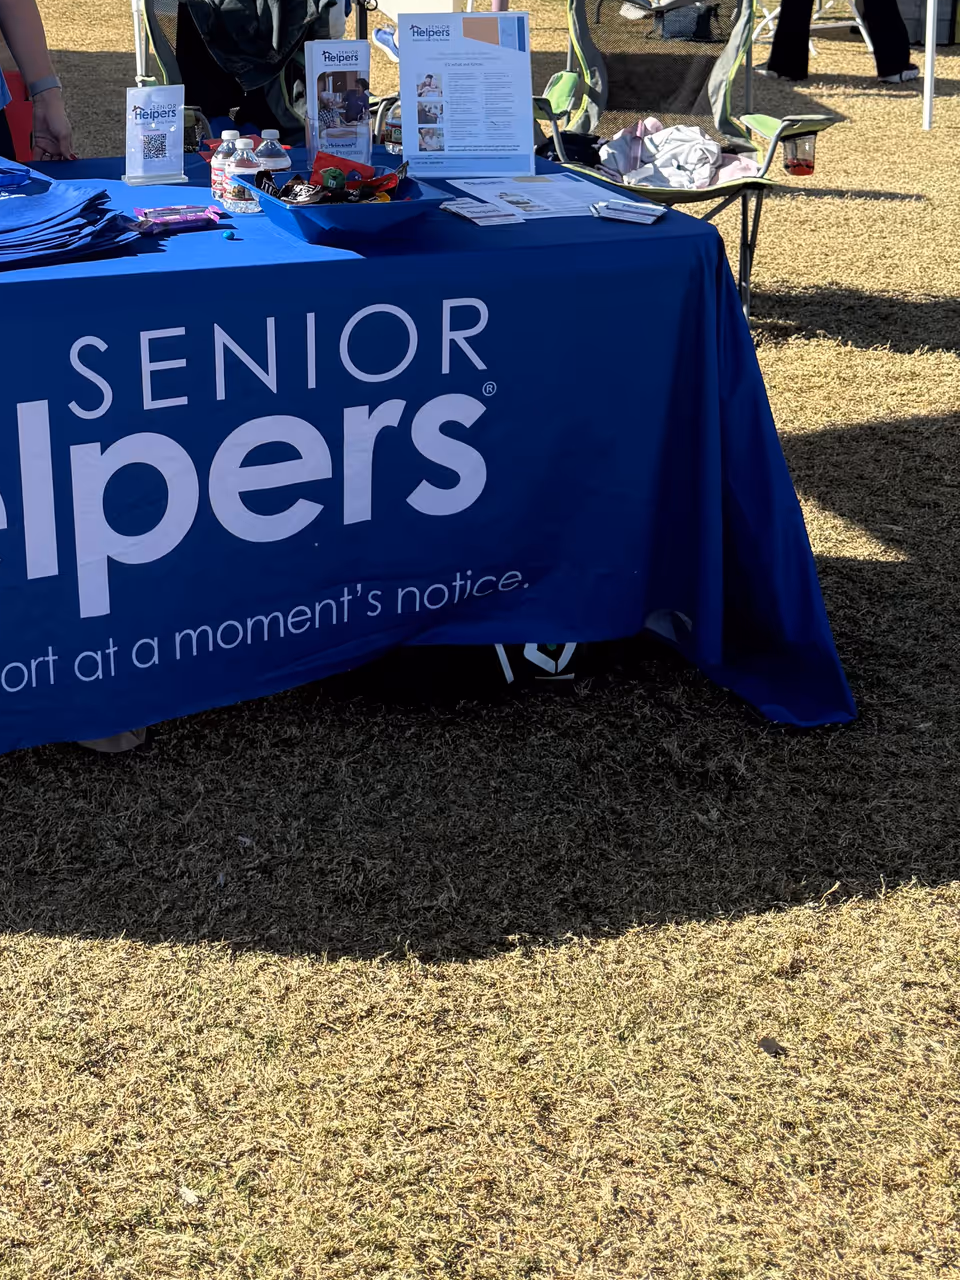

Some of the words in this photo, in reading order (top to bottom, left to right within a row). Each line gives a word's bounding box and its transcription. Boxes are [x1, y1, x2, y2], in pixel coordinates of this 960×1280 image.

[412, 28, 450, 39] Helpers
[324, 53, 359, 64] Helpers
[135, 109, 177, 121] Helpers
[68, 297, 488, 420] SENIOR
[74, 637, 119, 682] at
[132, 637, 159, 669] a
[175, 583, 383, 660] moment's
[397, 570, 530, 614] notice.
